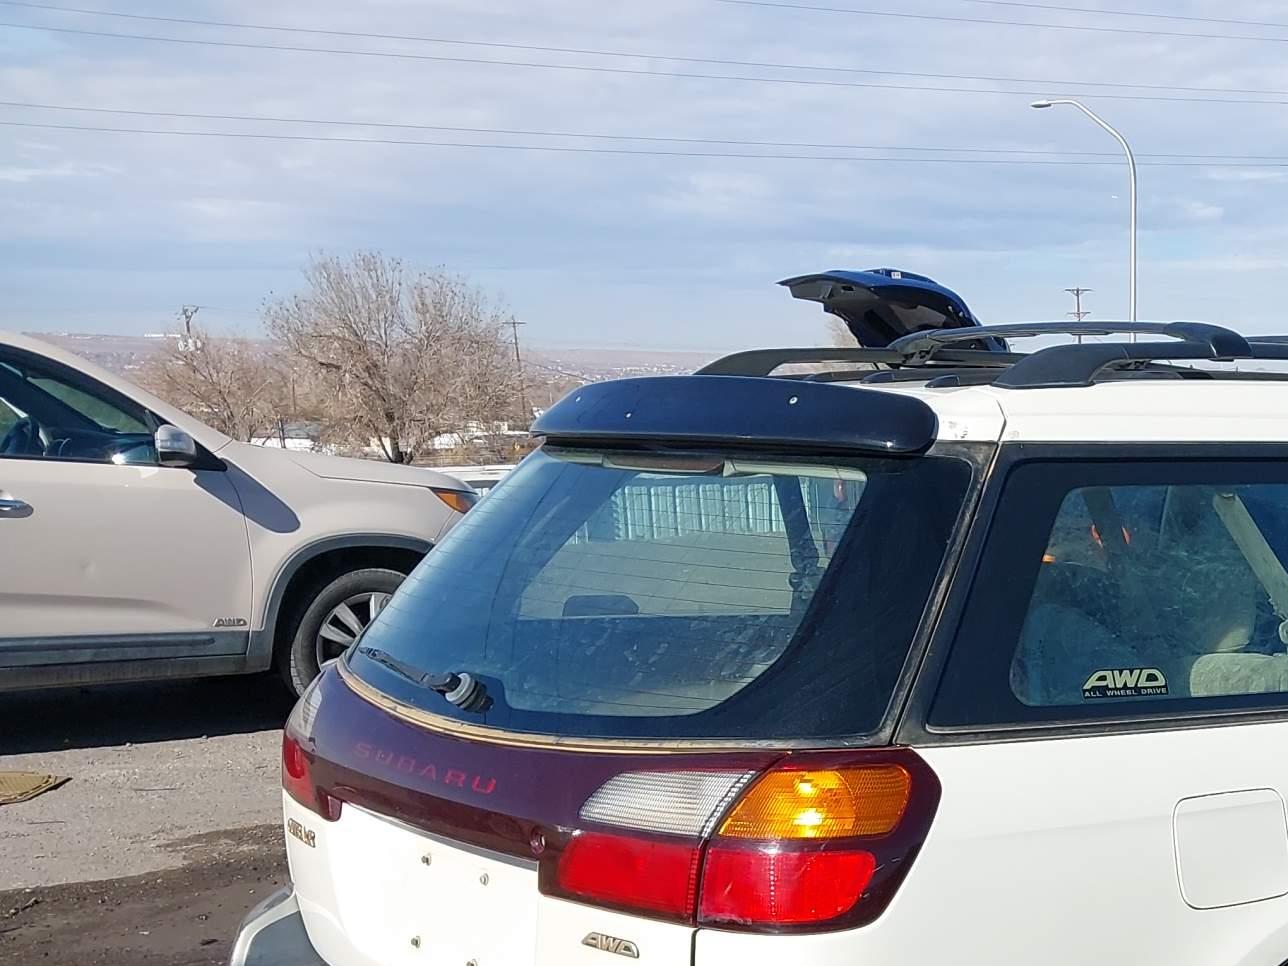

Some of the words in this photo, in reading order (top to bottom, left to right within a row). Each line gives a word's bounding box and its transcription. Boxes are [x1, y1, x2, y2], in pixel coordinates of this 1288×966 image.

[1082, 668, 1167, 690] AWD
[1106, 688, 1138, 697] WHEEL
[1141, 686, 1168, 695] DRIVE
[352, 742, 497, 794] SUBARU
[581, 931, 640, 959] AWD
